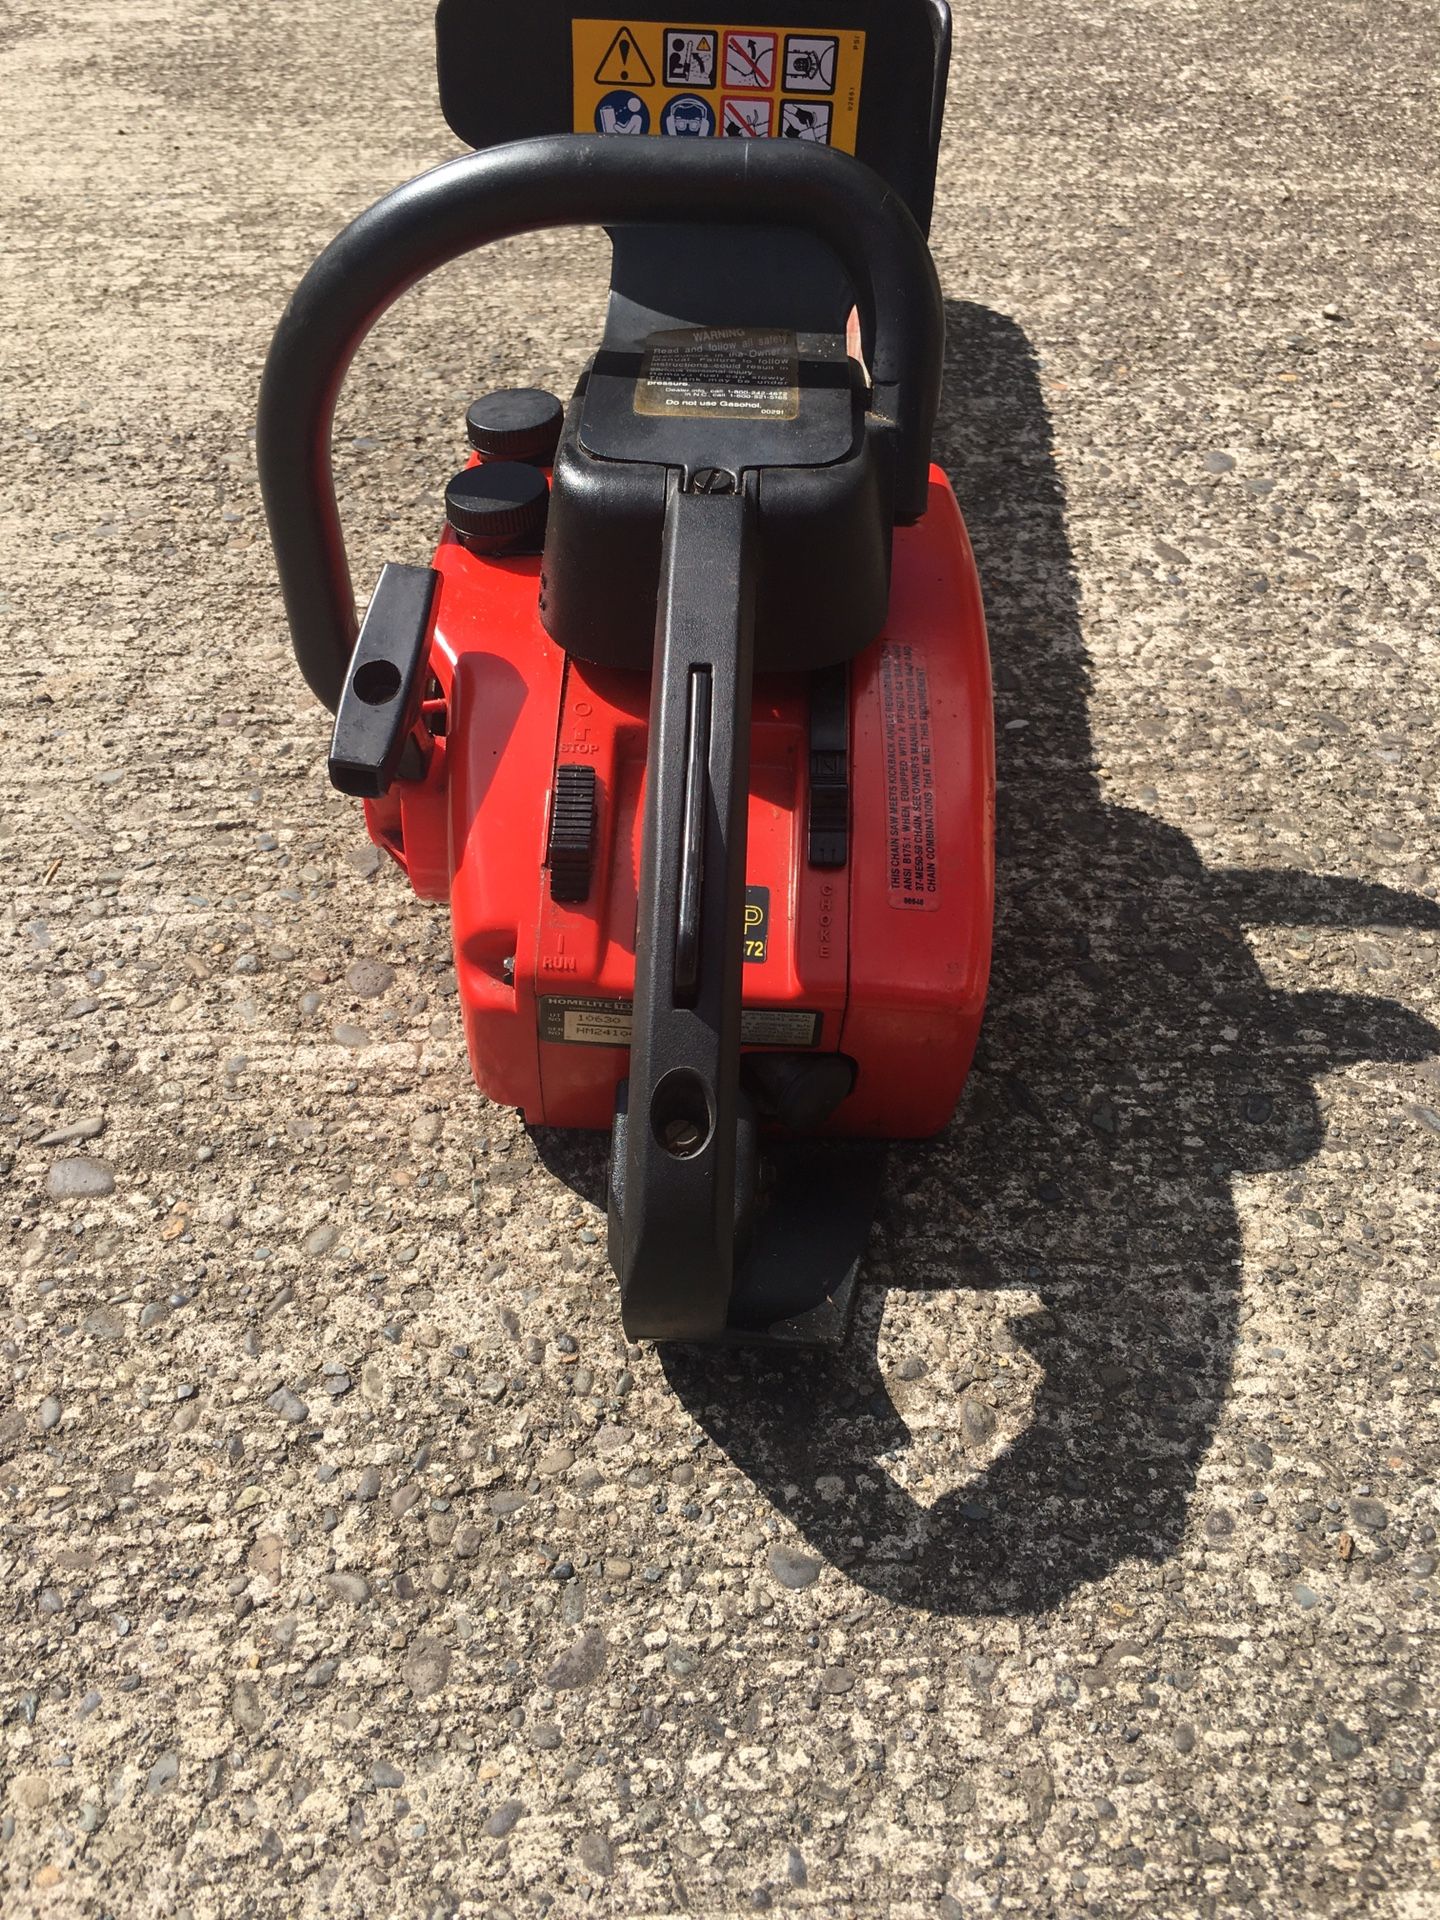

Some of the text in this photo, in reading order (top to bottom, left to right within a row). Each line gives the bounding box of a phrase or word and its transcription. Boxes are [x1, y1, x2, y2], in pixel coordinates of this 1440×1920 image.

[684, 345, 703, 353] and
[708, 341, 737, 352] follow
[742, 337, 754, 348] all
[758, 334, 787, 347] safety
[692, 328, 746, 342] WARNING
[719, 400, 762, 409] Gasohol.
[906, 680, 915, 702] OTHER
[907, 703, 916, 719] FOR
[886, 713, 896, 740] ANGLE
[920, 722, 929, 742] THIS
[898, 736, 908, 756] WITH
[909, 723, 919, 753] MANUAL
[560, 743, 599, 755] STOP
[921, 744, 931, 765] MEET
[887, 742, 898, 783] KICKBACK
[900, 760, 910, 801] EQUIPPED
[910, 756, 921, 794] OWNER'S
[922, 767, 932, 789] THAT
[888, 785, 898, 814] MEETS
[912, 795, 922, 811] SEE
[890, 816, 899, 836] SAW
[902, 807, 911, 832] WHEN
[924, 791, 935, 860] COMBINATIONS
[890, 838, 900, 867] CHAIN
[903, 837, 912, 864] B175.1
[891, 868, 900, 889] THIS
[903, 868, 912, 890] ANSI
[926, 863, 936, 892] CHAIN
[820, 884, 833, 959] CHOKE
[743, 941, 764, 957] 72
[542, 956, 577, 972] RUN
[548, 998, 613, 1009] HOMELITE
[578, 1014, 621, 1024] 10630
